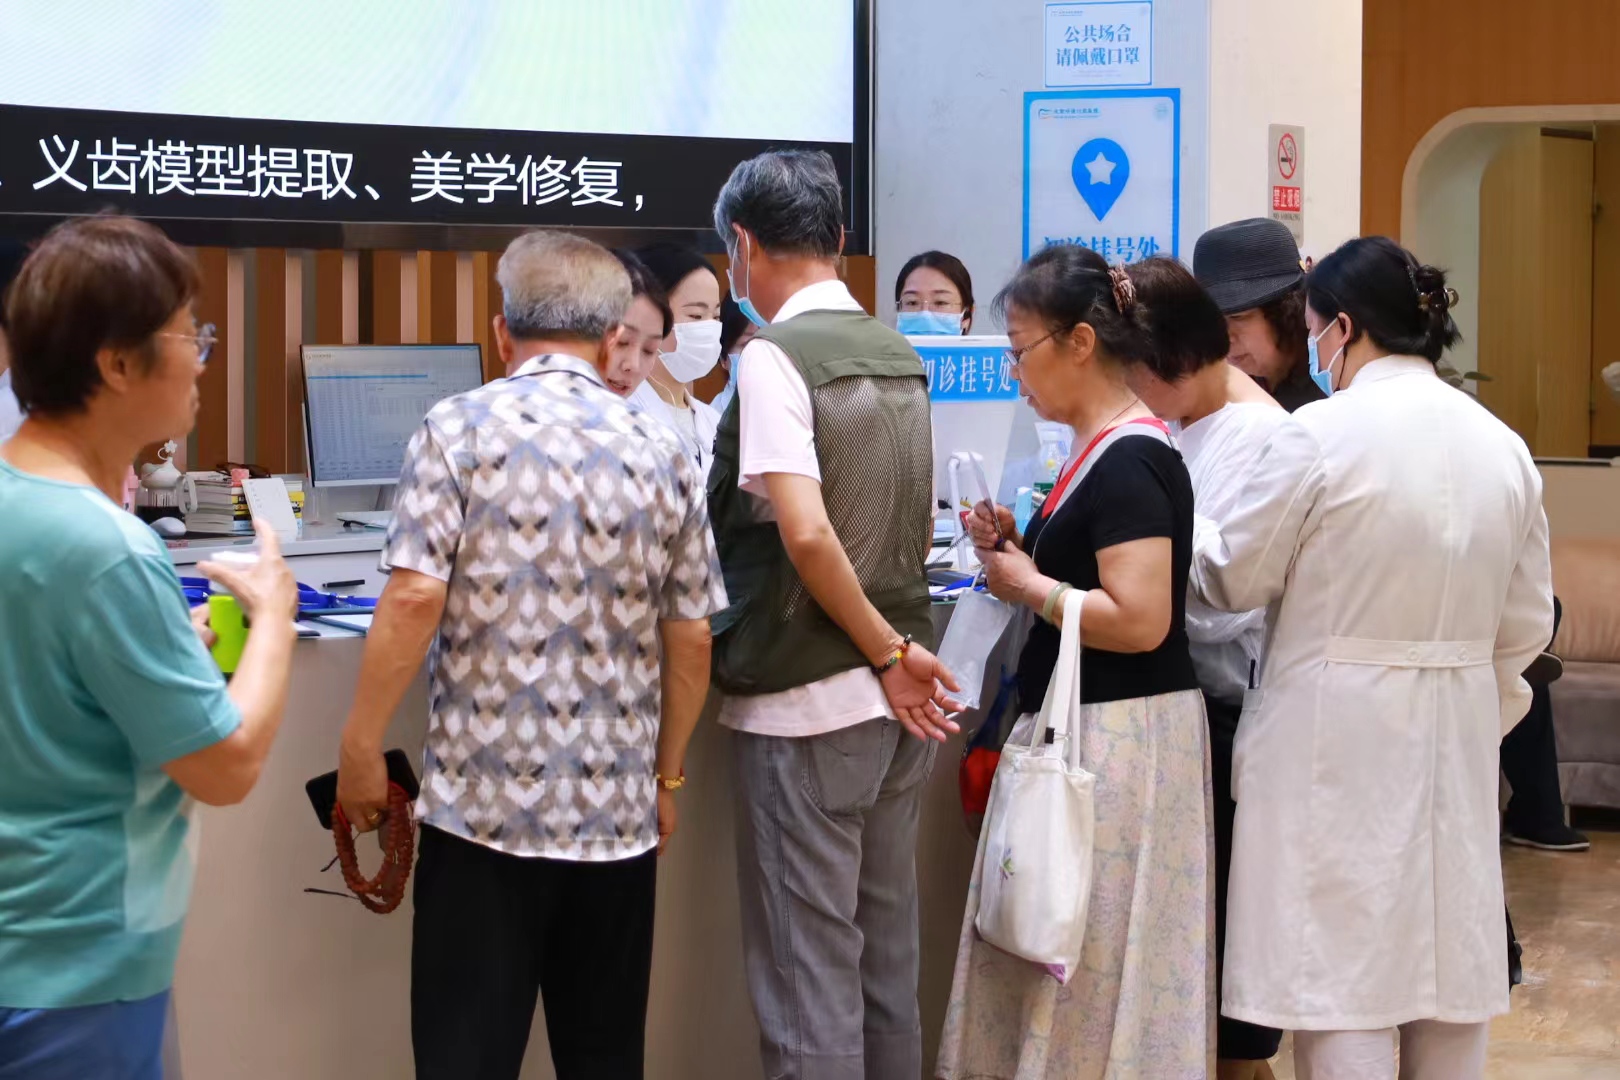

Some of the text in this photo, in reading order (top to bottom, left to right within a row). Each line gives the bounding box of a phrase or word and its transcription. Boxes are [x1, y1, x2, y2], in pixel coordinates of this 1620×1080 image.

[1064, 23, 1131, 43] 公共场合
[1056, 46, 1139, 67] 请佩戴口罩
